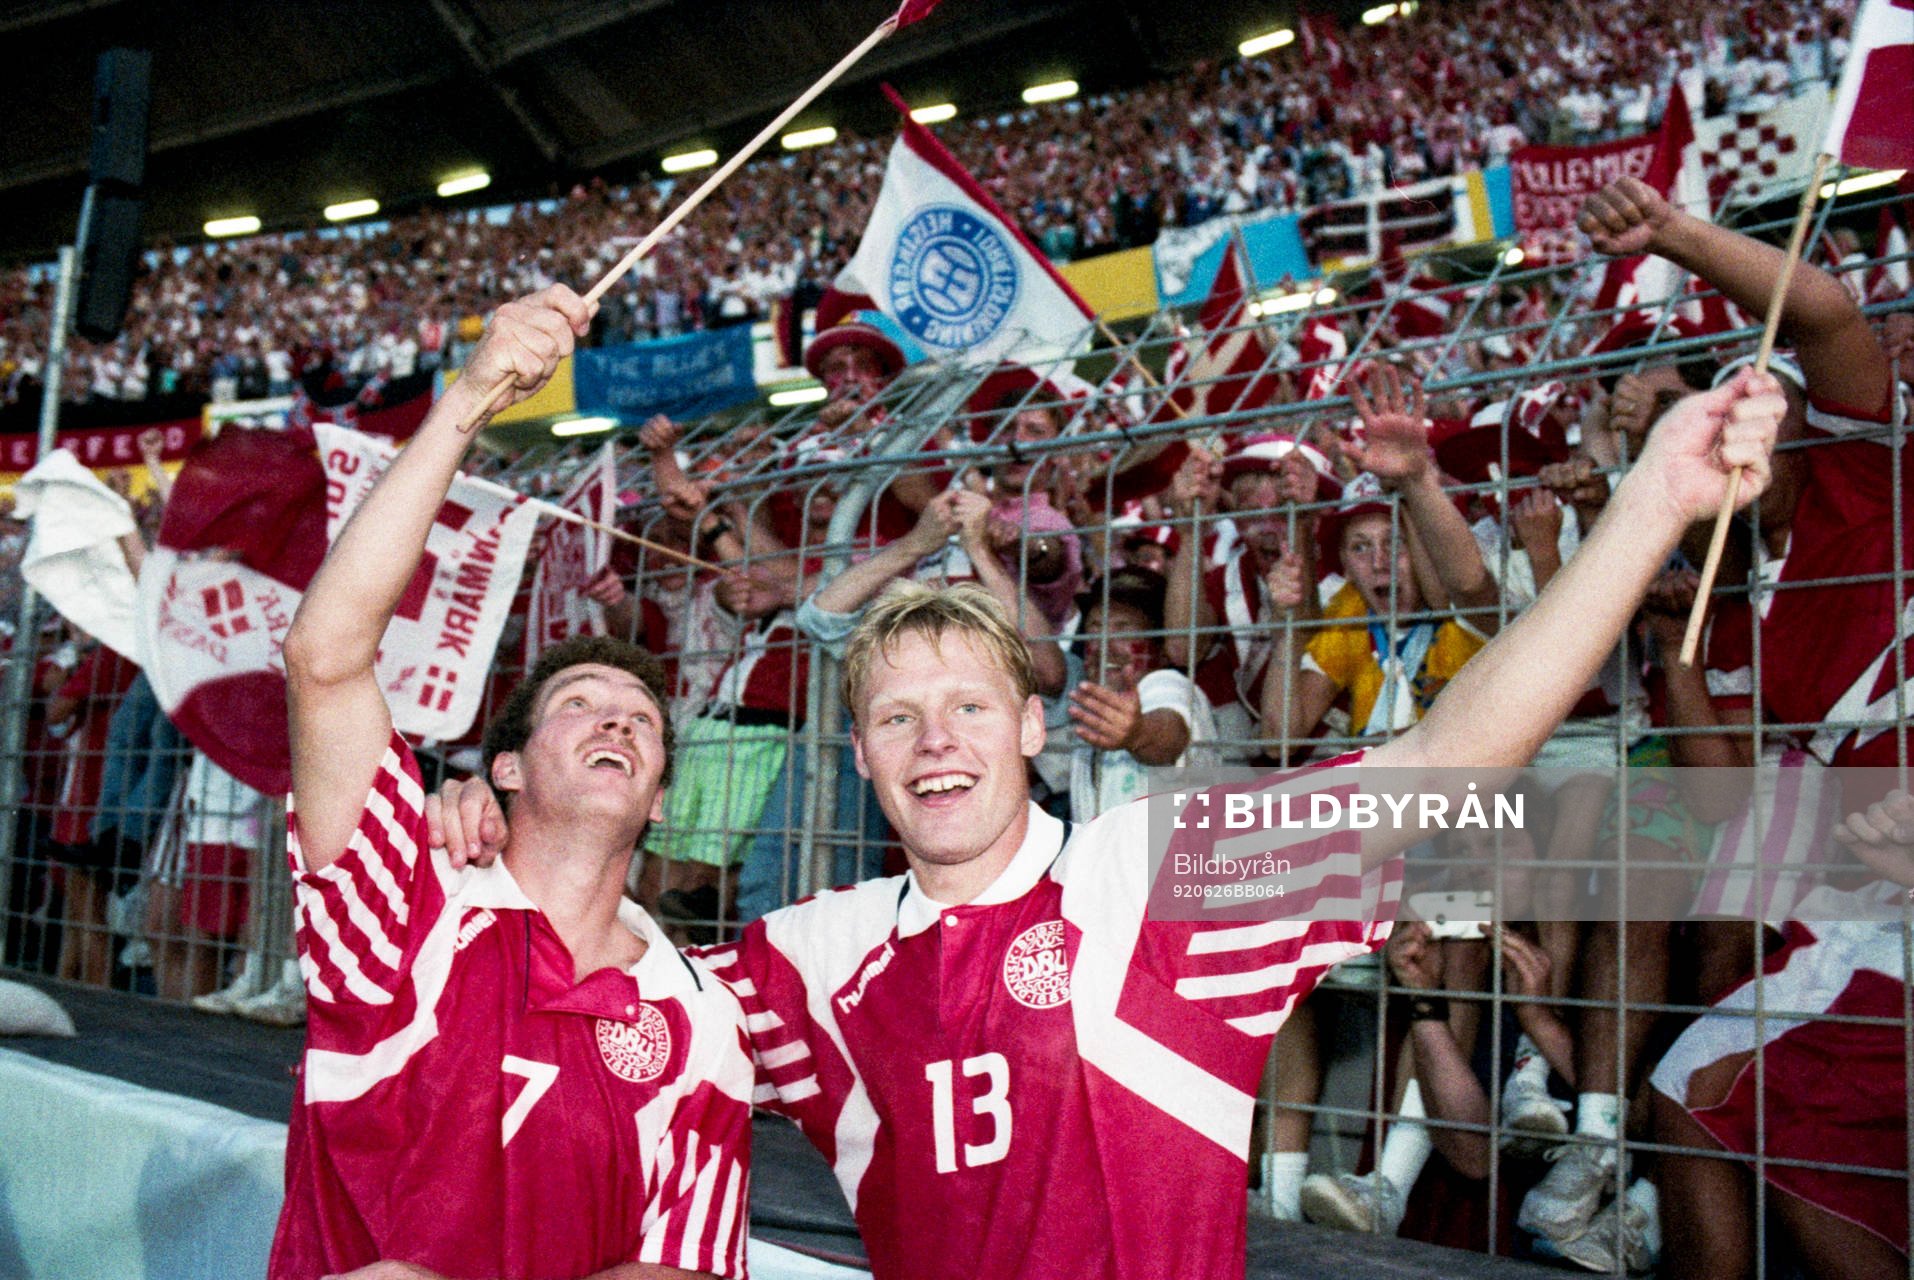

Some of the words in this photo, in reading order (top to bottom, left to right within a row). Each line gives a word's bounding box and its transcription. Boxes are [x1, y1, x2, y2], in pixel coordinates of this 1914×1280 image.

[454, 908, 497, 952] ummel
[610, 1021, 656, 1061] DBU
[501, 1054, 560, 1149] 7
[925, 1052, 1013, 1174] 13
